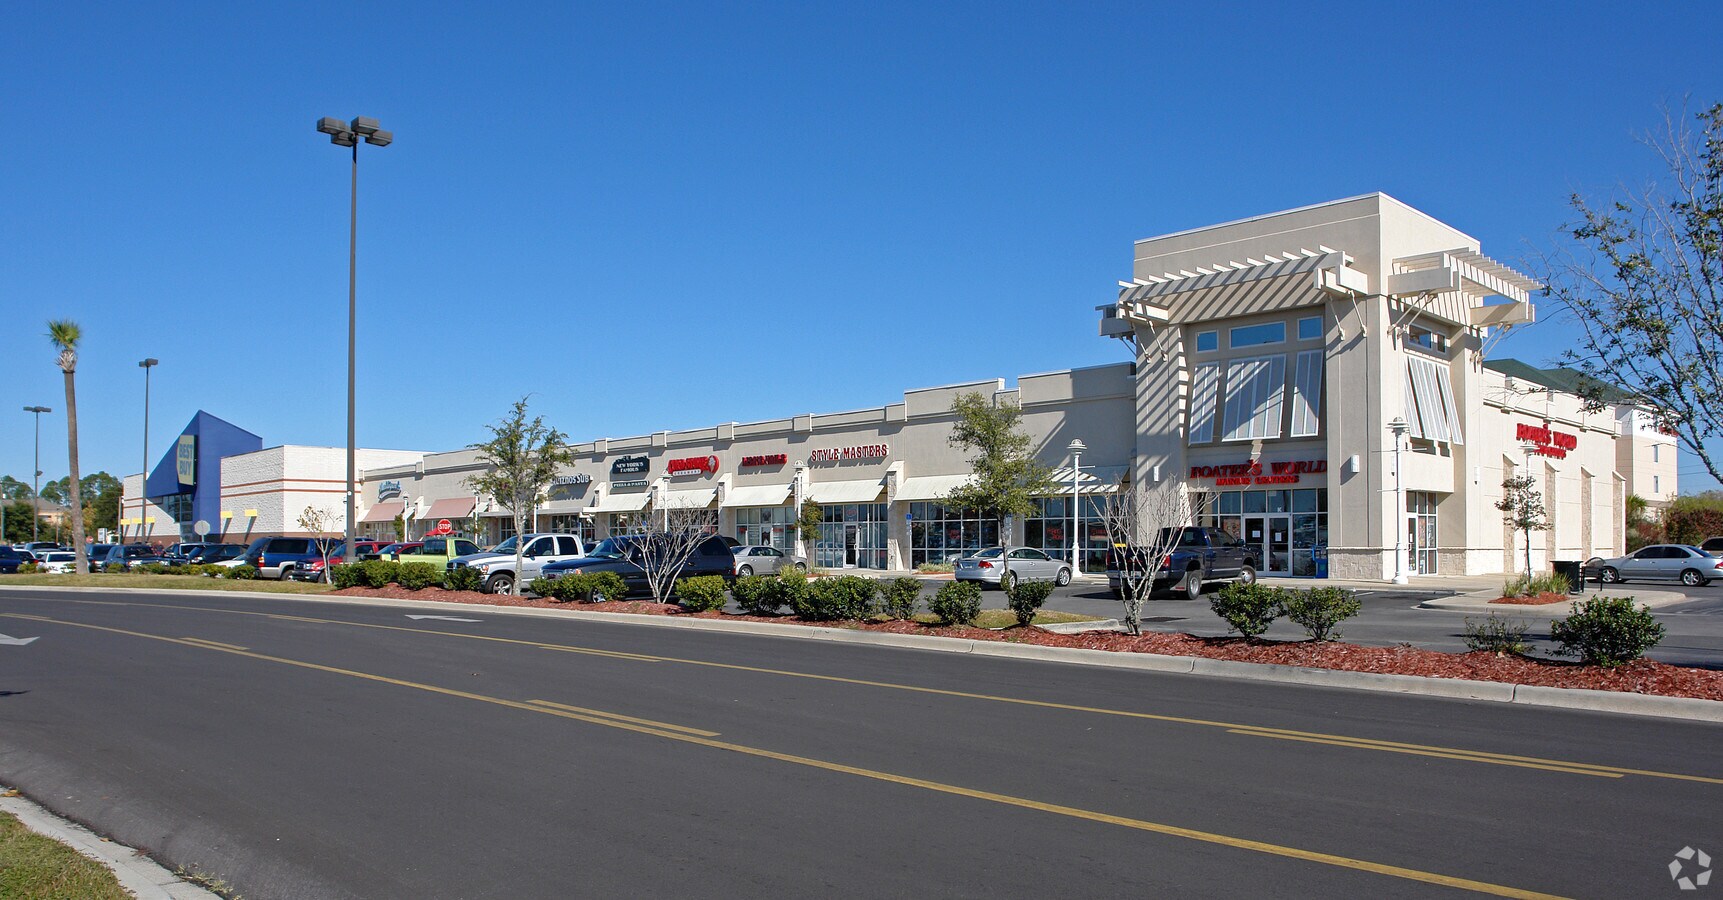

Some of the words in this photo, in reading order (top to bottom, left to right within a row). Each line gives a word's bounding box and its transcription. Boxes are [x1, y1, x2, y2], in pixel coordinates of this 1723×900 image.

[179, 443, 193, 459] BEST
[811, 448, 840, 461] STYLE
[843, 444, 889, 459] MASTERS
[179, 460, 191, 475] BUY
[1271, 460, 1327, 475] WORLD
[577, 473, 590, 484] SUB
